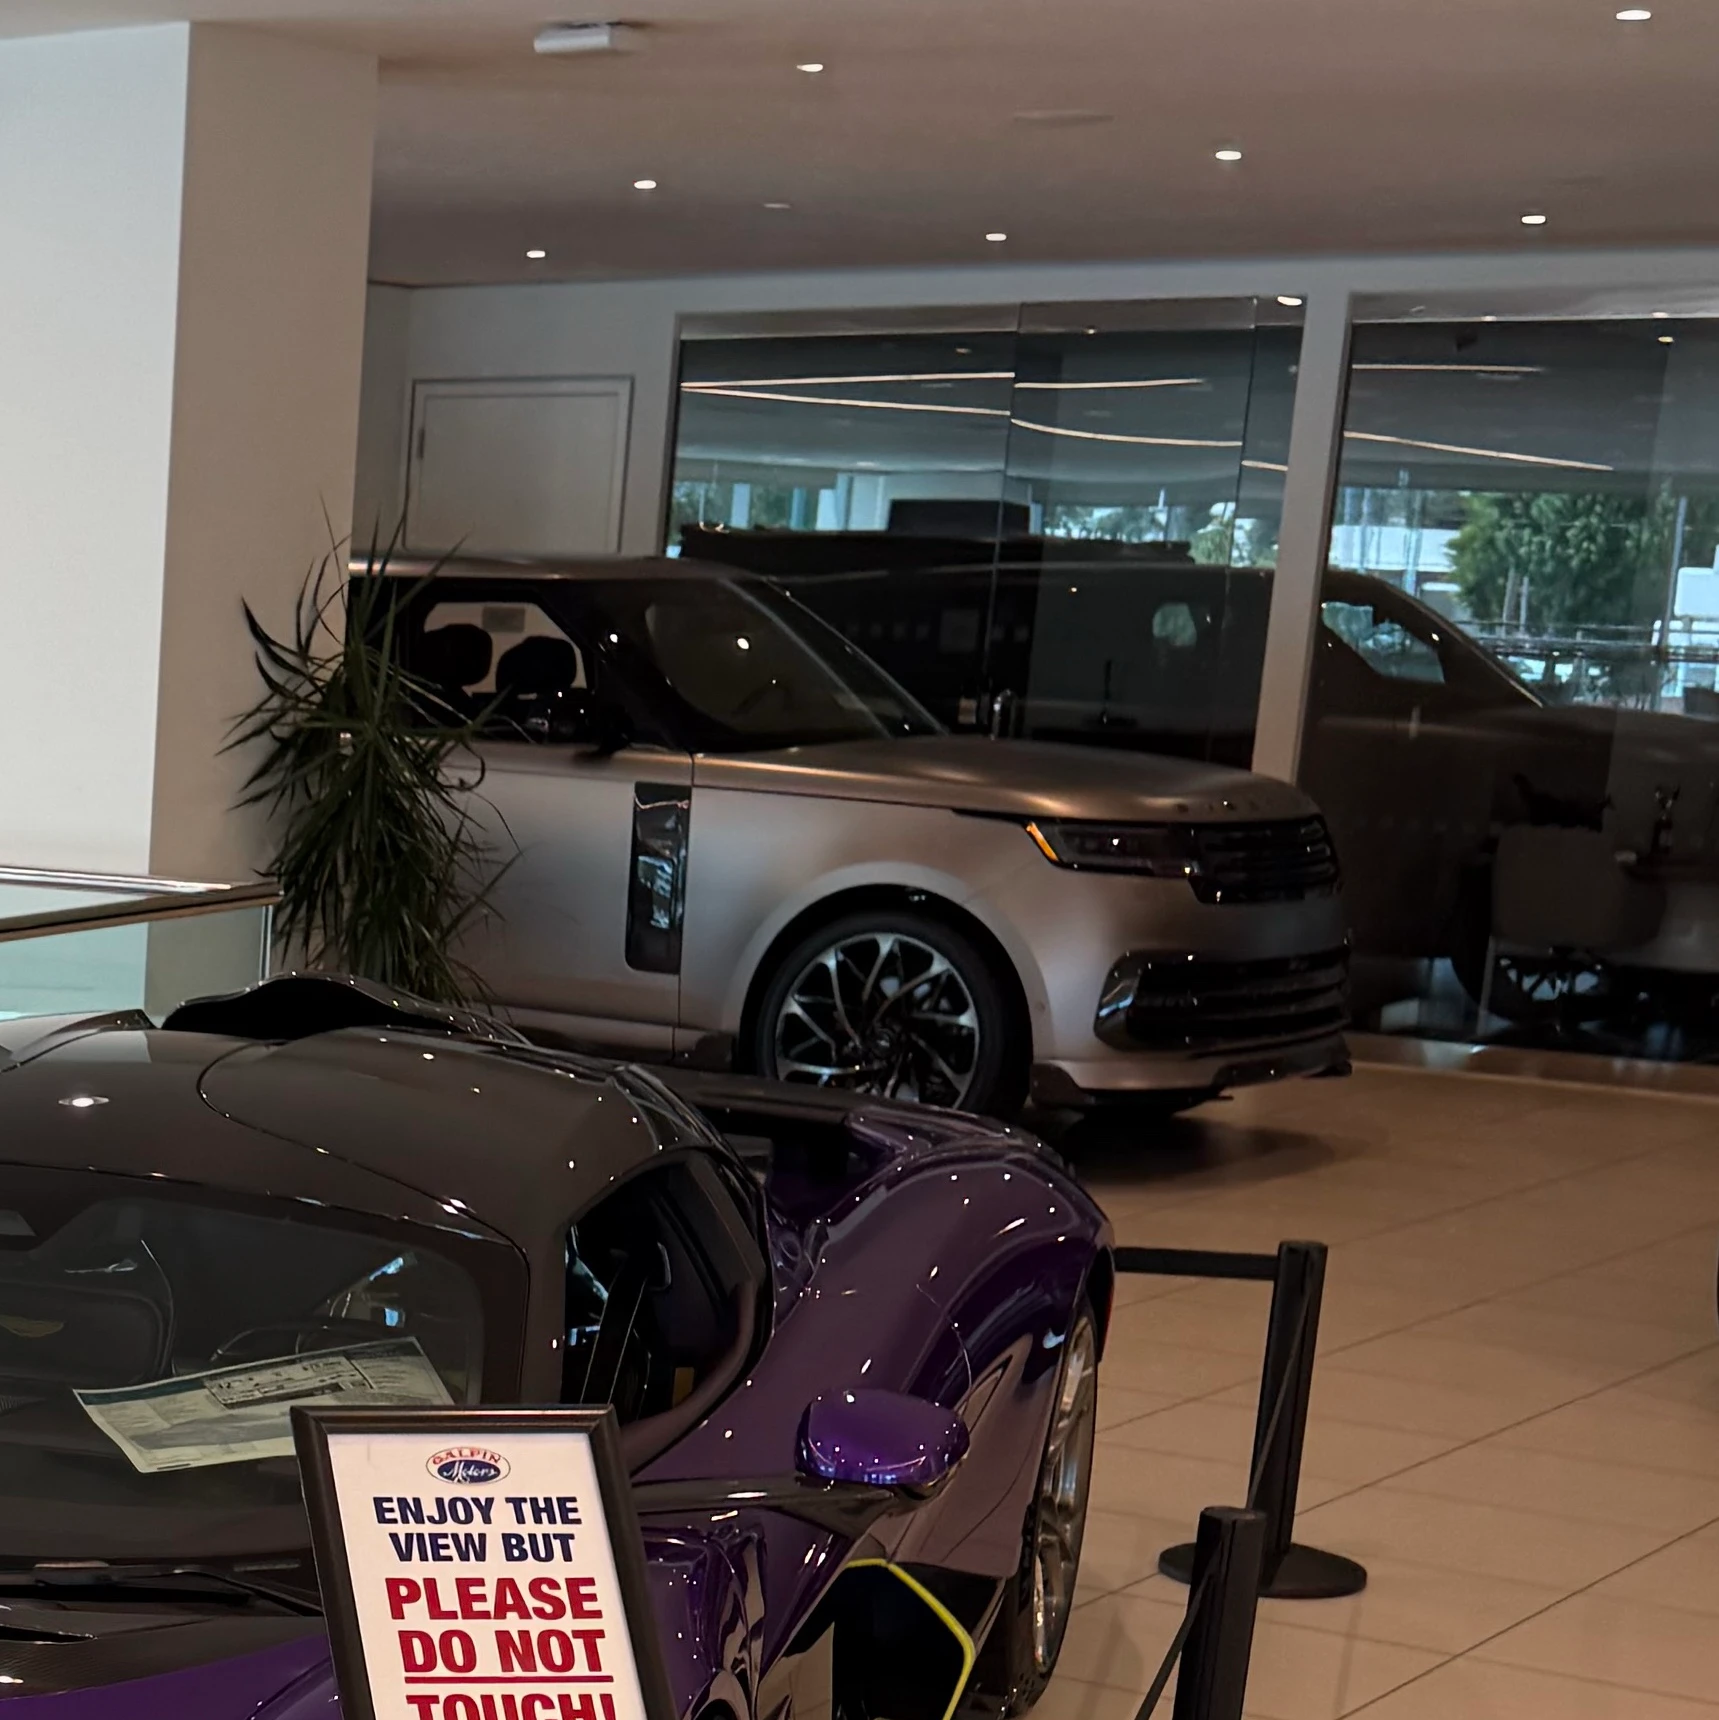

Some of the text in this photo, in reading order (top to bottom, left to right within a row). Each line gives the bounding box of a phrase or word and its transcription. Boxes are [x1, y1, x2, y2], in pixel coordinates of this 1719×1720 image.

[432, 1448, 501, 1465] GALPIN
[443, 1460, 499, 1484] Motors
[373, 1497, 582, 1524] ENJOY THE
[389, 1533, 575, 1562] VIEW BUT
[385, 1577, 603, 1620] PLEASE
[398, 1629, 605, 1673] DO NOT
